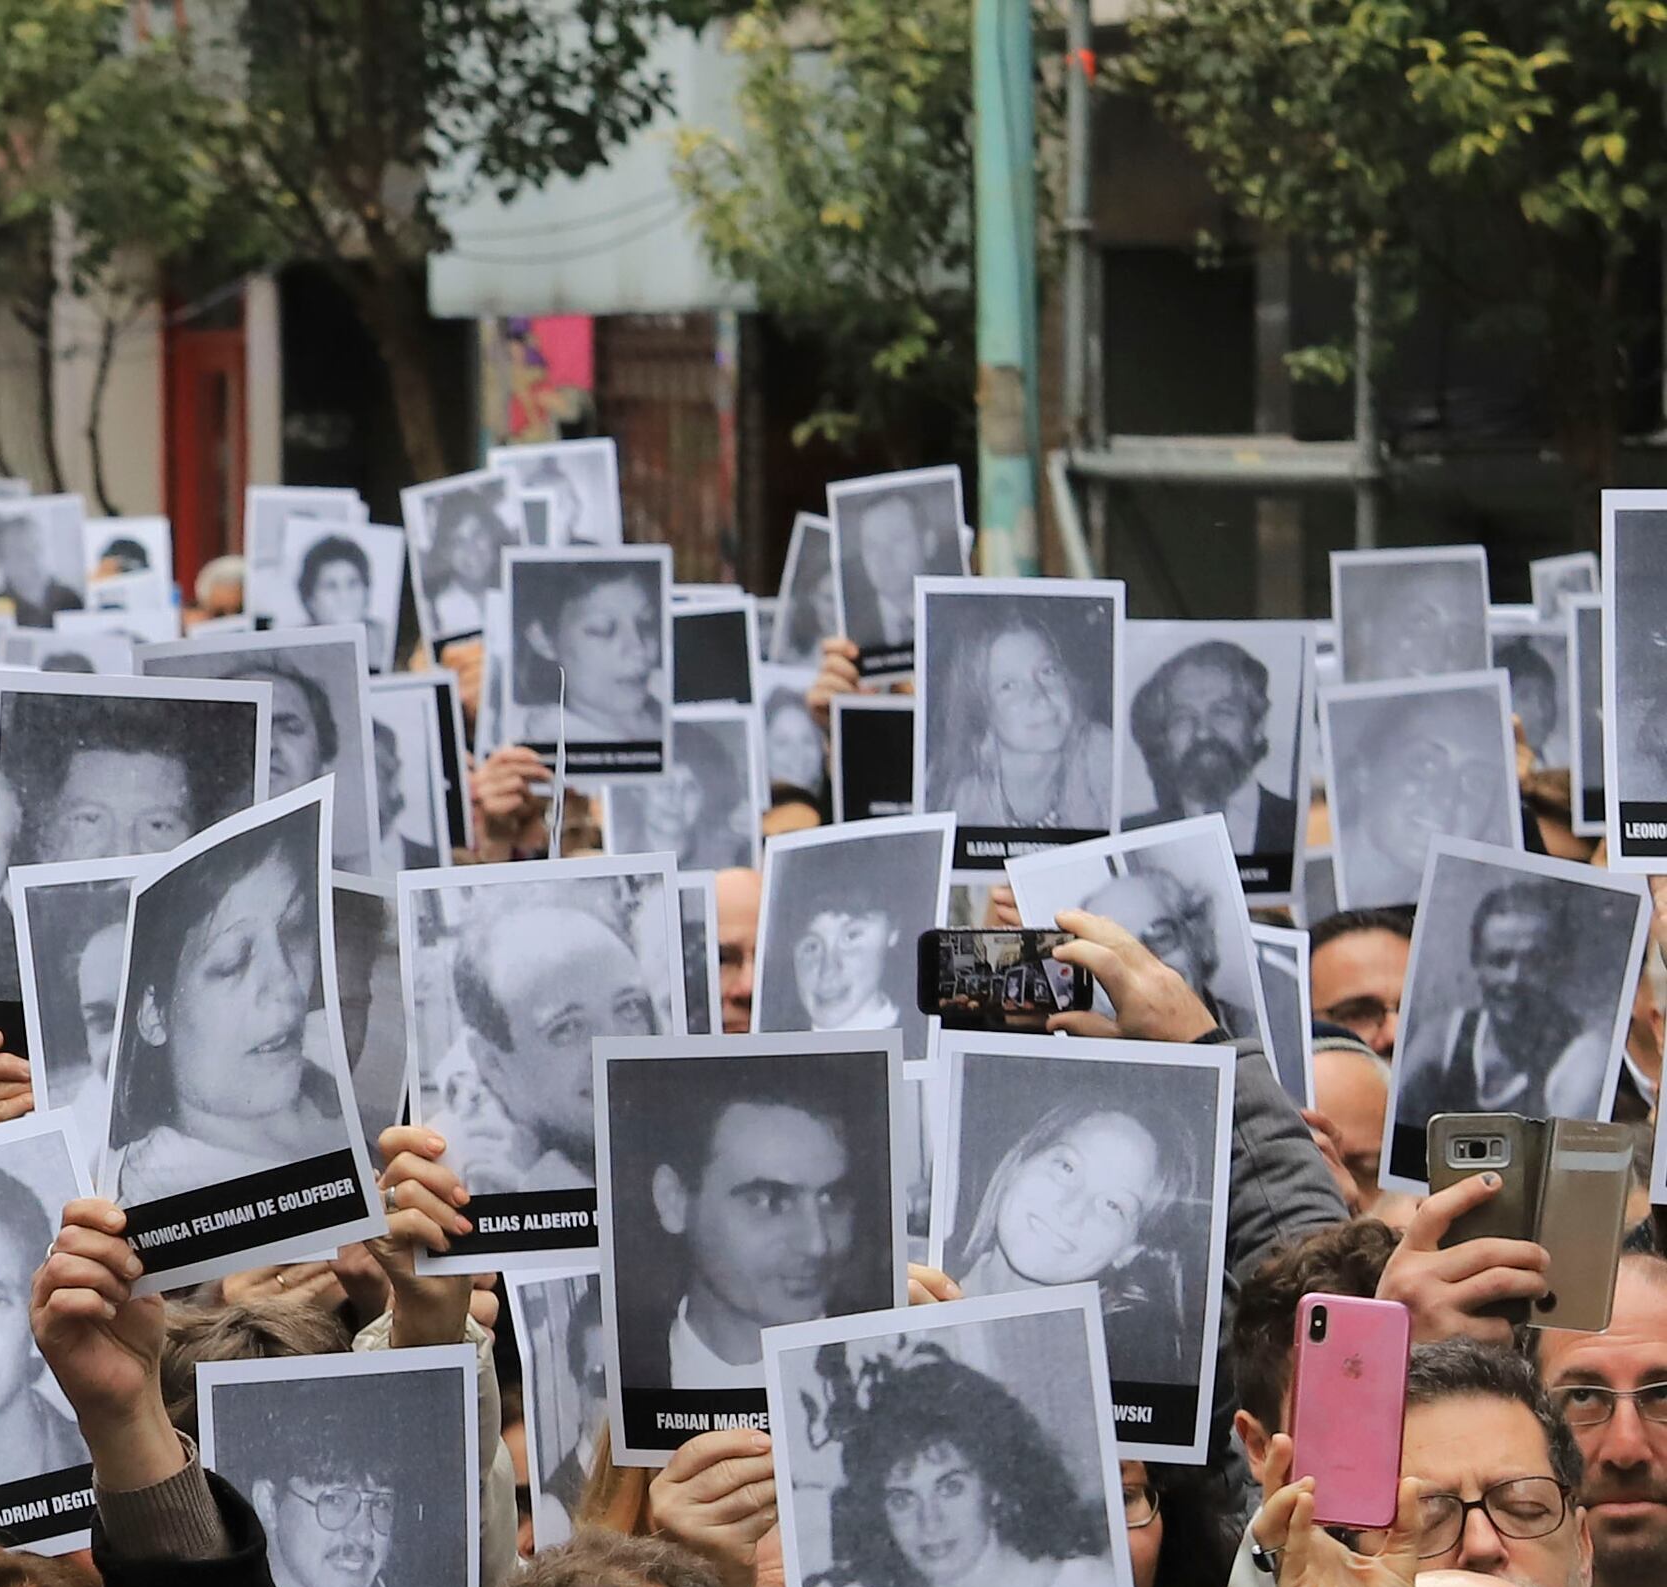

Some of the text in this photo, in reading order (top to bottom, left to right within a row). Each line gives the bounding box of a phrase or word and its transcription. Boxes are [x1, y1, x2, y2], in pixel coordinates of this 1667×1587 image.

[1625, 822, 1667, 840] LEONO
[138, 1222, 191, 1250] MONICA
[192, 1204, 256, 1237] FELDMAN
[258, 1198, 278, 1218] DE
[278, 1178, 356, 1214] GOLDFEDER
[478, 1214, 521, 1234] ELIAS
[523, 1211, 589, 1231] ALBERTO
[656, 1412, 768, 1431] FABIAN MARCE
[1113, 1405, 1153, 1423] WSKI
[51, 1488, 97, 1514] DEGTI
